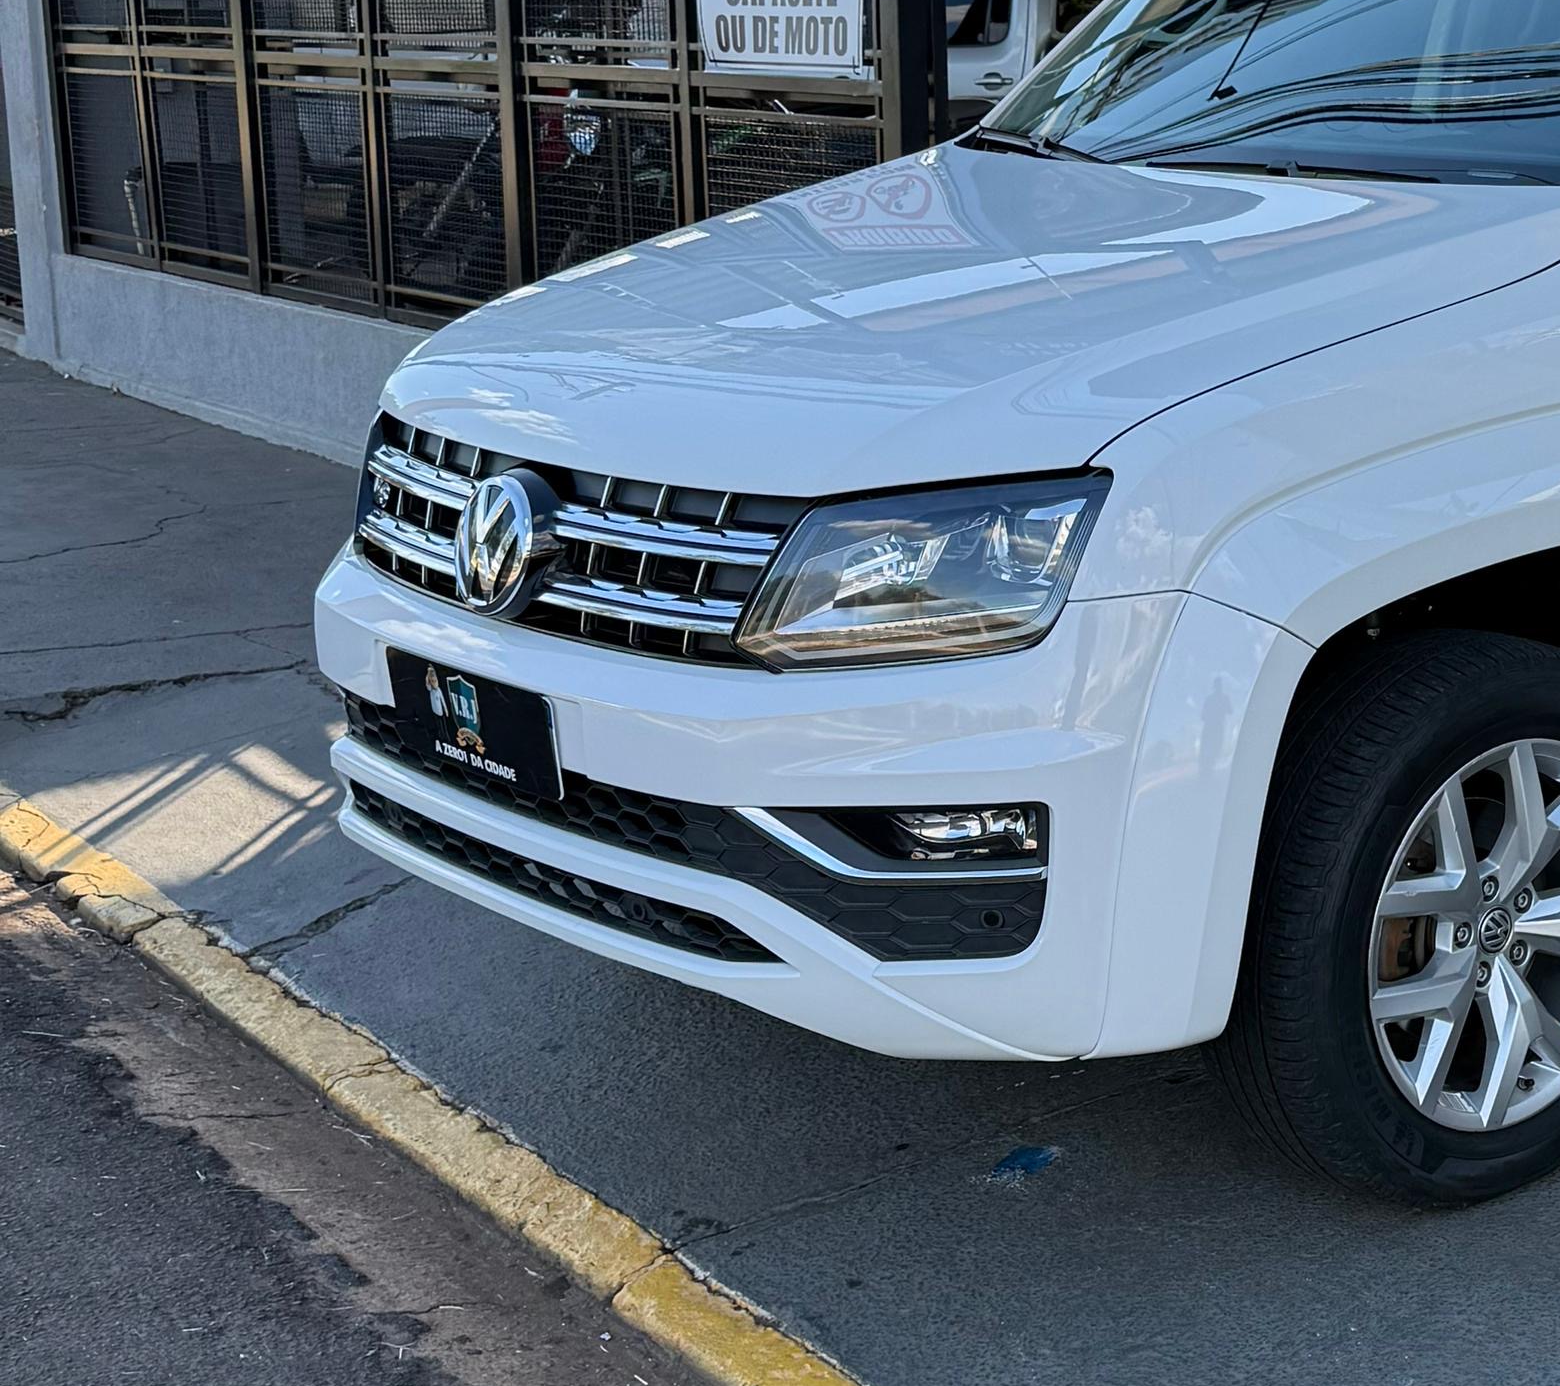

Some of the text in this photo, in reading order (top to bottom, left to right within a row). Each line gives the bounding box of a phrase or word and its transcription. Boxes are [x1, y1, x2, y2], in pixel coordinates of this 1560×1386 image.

[715, 14, 848, 56] OU DE MOTO
[470, 753, 484, 769] DA
[484, 759, 517, 781] CIDADE
